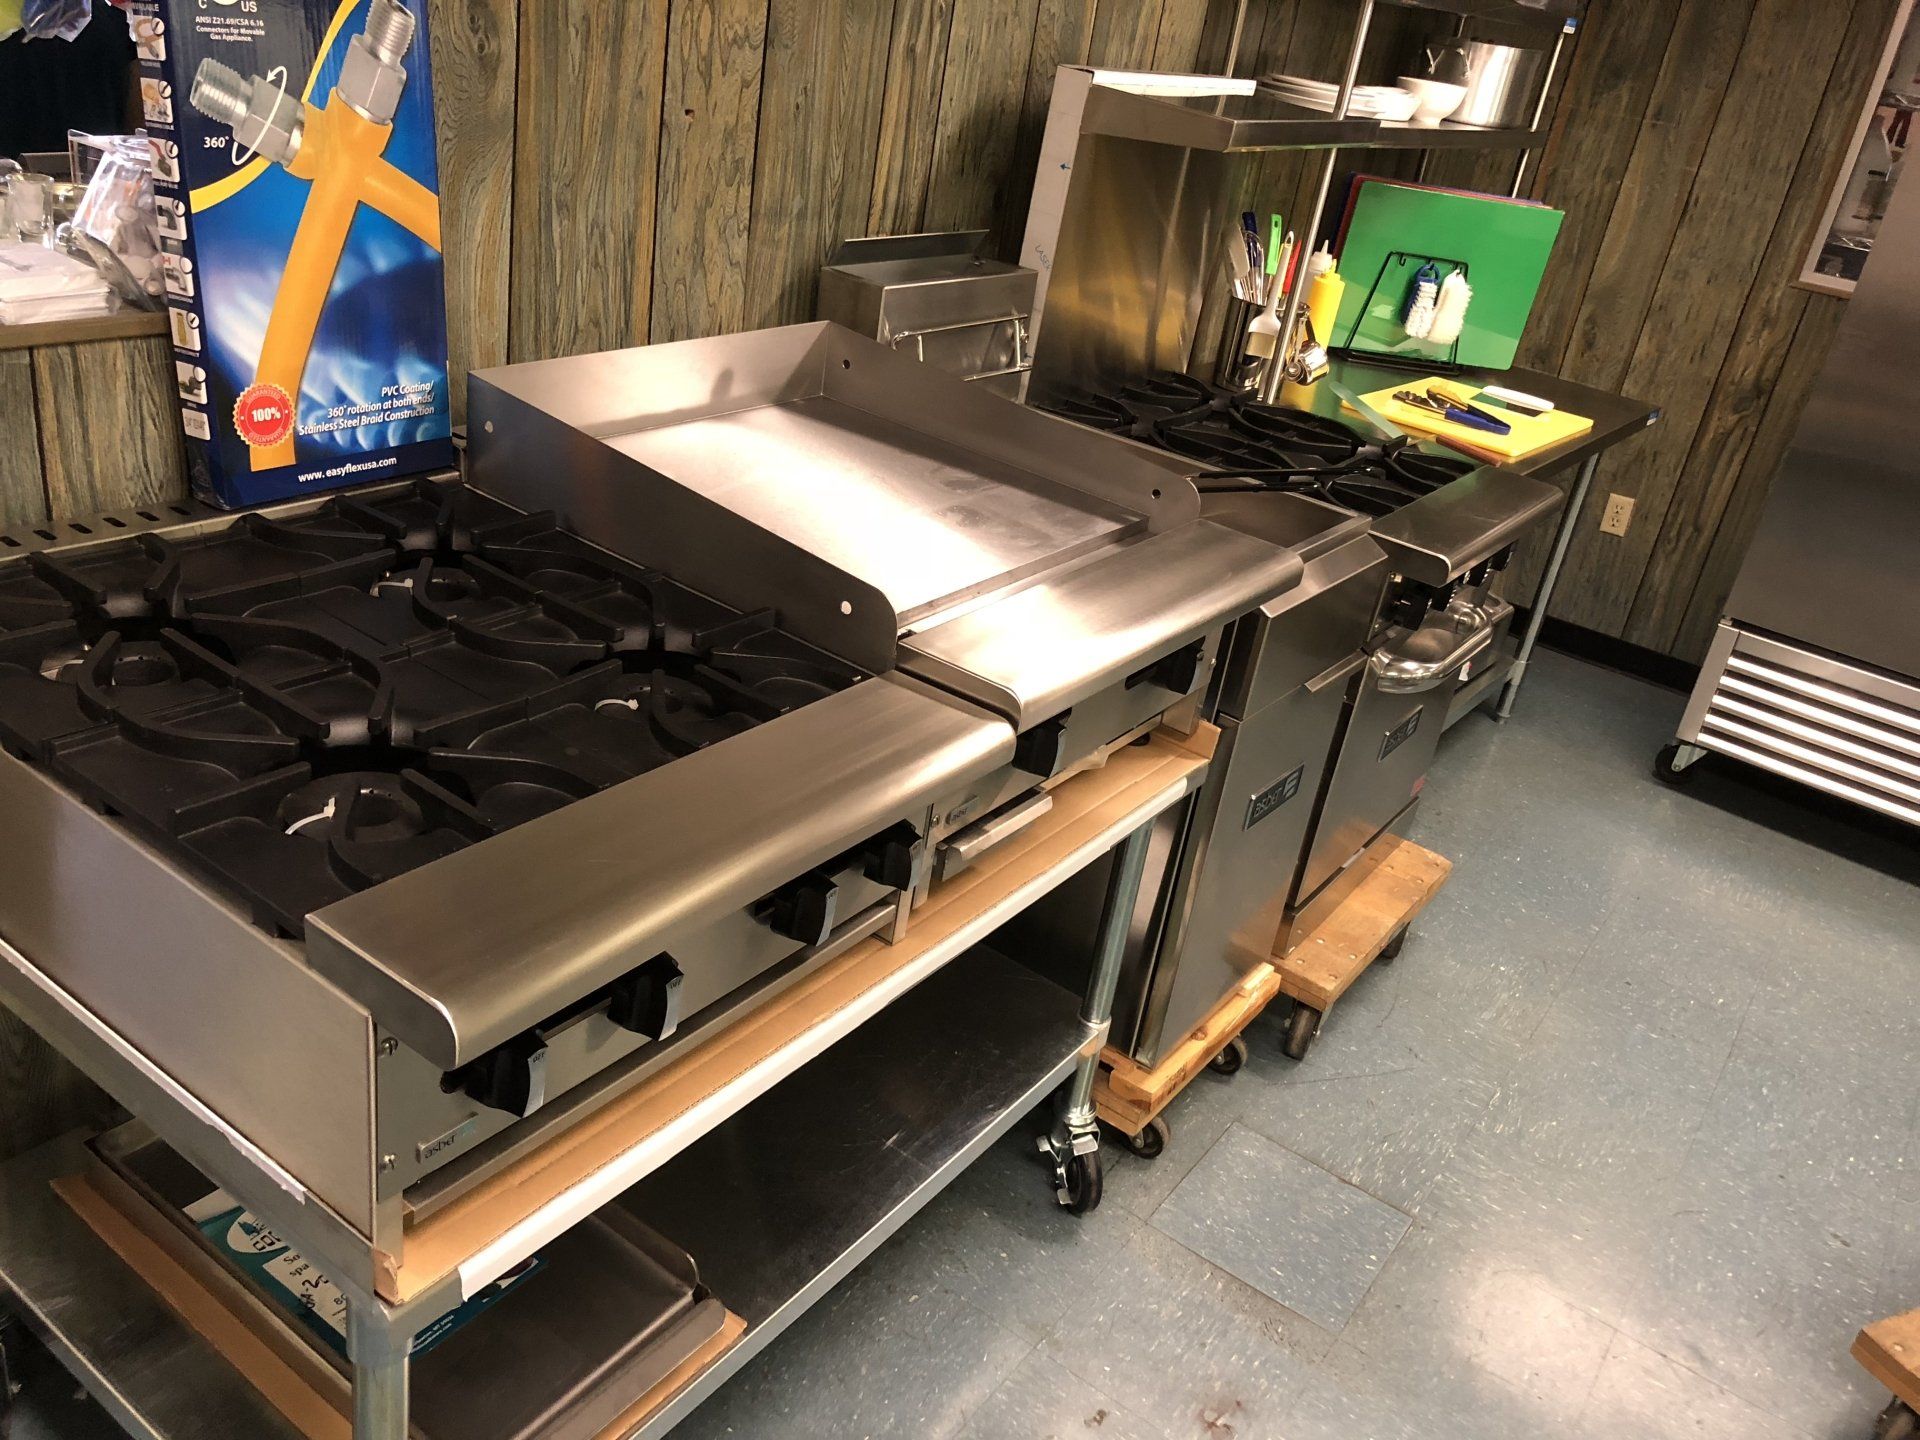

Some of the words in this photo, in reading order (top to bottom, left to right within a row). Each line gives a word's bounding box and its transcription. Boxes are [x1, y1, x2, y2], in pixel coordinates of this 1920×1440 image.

[241, 1, 258, 13] US
[195, 16, 212, 24] ANSI
[196, 25, 230, 34] Connectors
[240, 28, 266, 36] Movable
[381, 385, 399, 398] PVC
[399, 380, 435, 395] Coating/
[347, 402, 382, 415] rotation
[382, 400, 392, 410] at
[392, 396, 412, 408] both
[251, 406, 282, 423] 100%
[298, 421, 338, 436] Stainless
[339, 416, 360, 430] Steel
[360, 411, 384, 426] Braid
[384, 406, 435, 422] Construction
